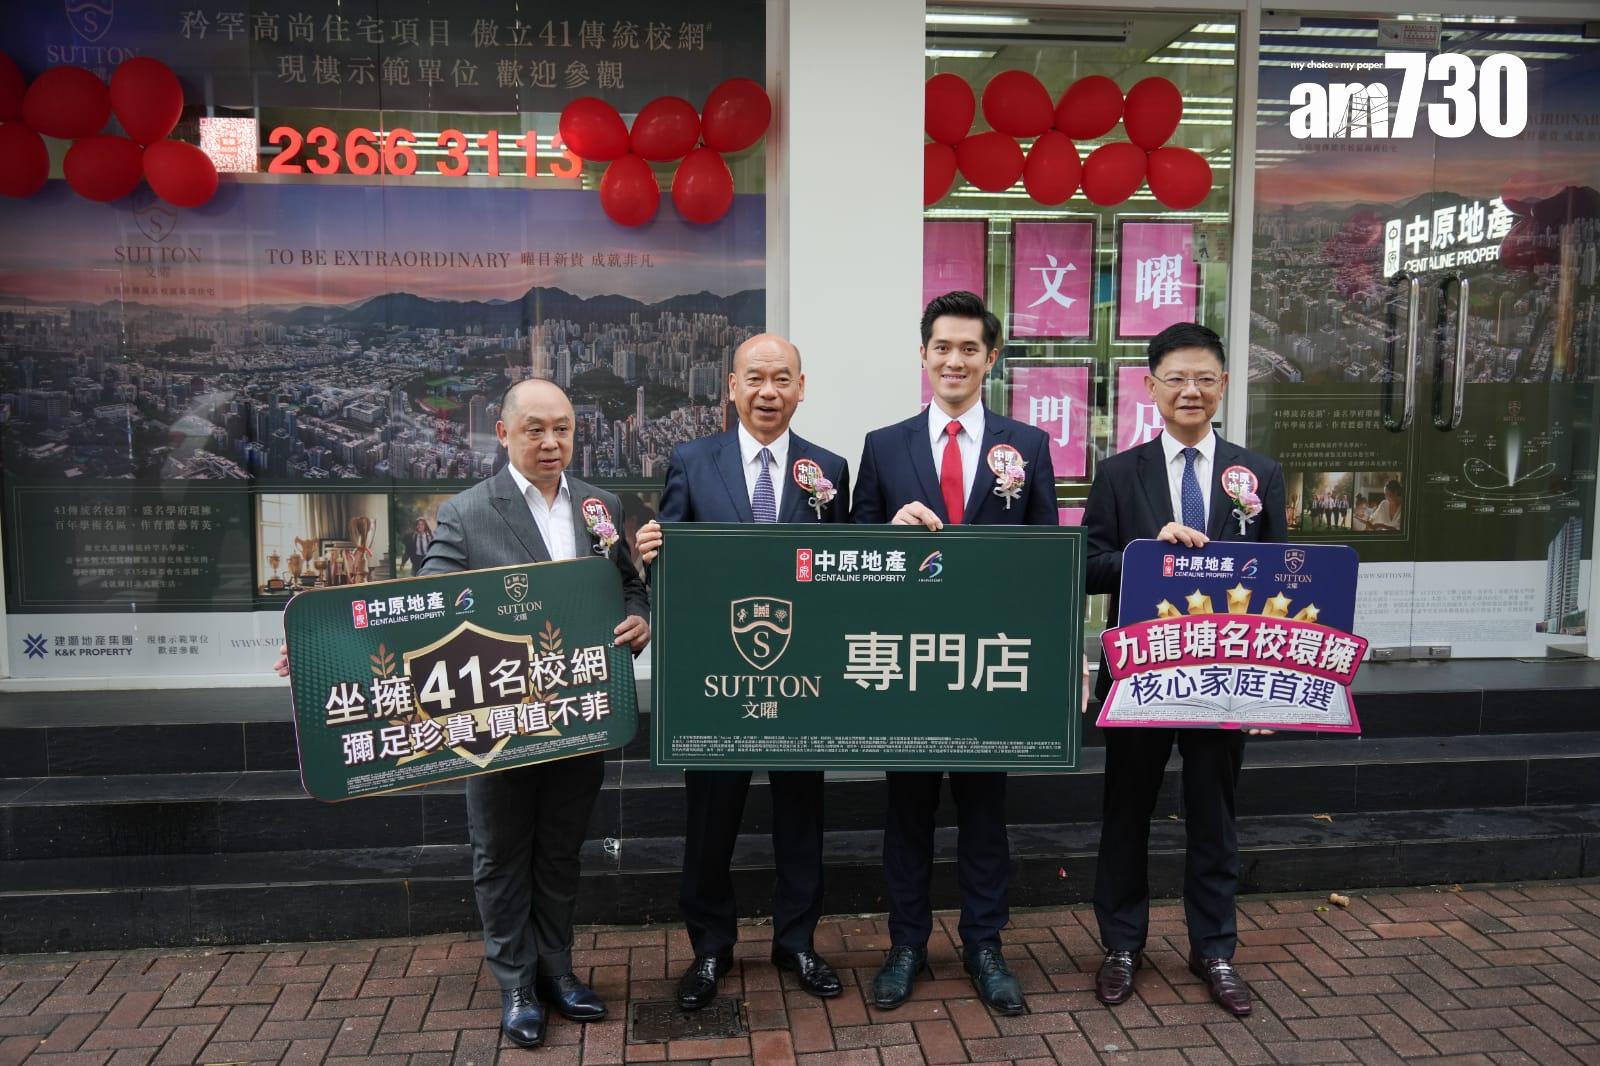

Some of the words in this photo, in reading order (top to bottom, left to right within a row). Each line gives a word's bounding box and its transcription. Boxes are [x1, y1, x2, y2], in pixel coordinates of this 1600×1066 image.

[179, 10, 449, 48] 矜罕高尚住宅項目
[277, 55, 480, 88] 現樓示範單位
[496, 59, 625, 90] 歡迎參觀
[268, 126, 418, 176] 2366
[436, 128, 583, 178] 3113
[1404, 196, 1514, 254] 中原地產
[114, 246, 203, 264] SUTTON
[265, 248, 294, 266] TO
[302, 249, 328, 266] BE
[334, 250, 511, 268] EXTRAORDINARY
[1403, 252, 1456, 273] CENTALINE
[1456, 244, 1501, 266] PROPER
[1028, 254, 1077, 309] 文
[1135, 254, 1183, 309] 曜
[1029, 396, 1071, 448] 門
[814, 550, 906, 573] 中原地產
[1175, 556, 1234, 572] 中原地產
[814, 574, 861, 582] CENTALINE
[862, 574, 906, 582] PROPERTY
[1274, 573, 1313, 583] SUTTON
[368, 591, 445, 618] 中原地產
[370, 615, 409, 626] CENTALINE
[410, 610, 446, 621] PROPERTY
[497, 601, 543, 616] SUTTON
[55, 648, 76, 656] K&K
[79, 648, 133, 656] PROPERTY
[1114, 620, 1359, 675] 九龍塘名校環擁
[843, 632, 1032, 692] 專門店
[325, 644, 609, 727] 坐擁41名校網
[704, 675, 821, 698] SUTTON
[1129, 664, 1336, 712] 核心家庭首選
[741, 700, 778, 719] 文曜
[343, 712, 476, 765] 彌足珍貴
[488, 691, 611, 739] 價值不菲
